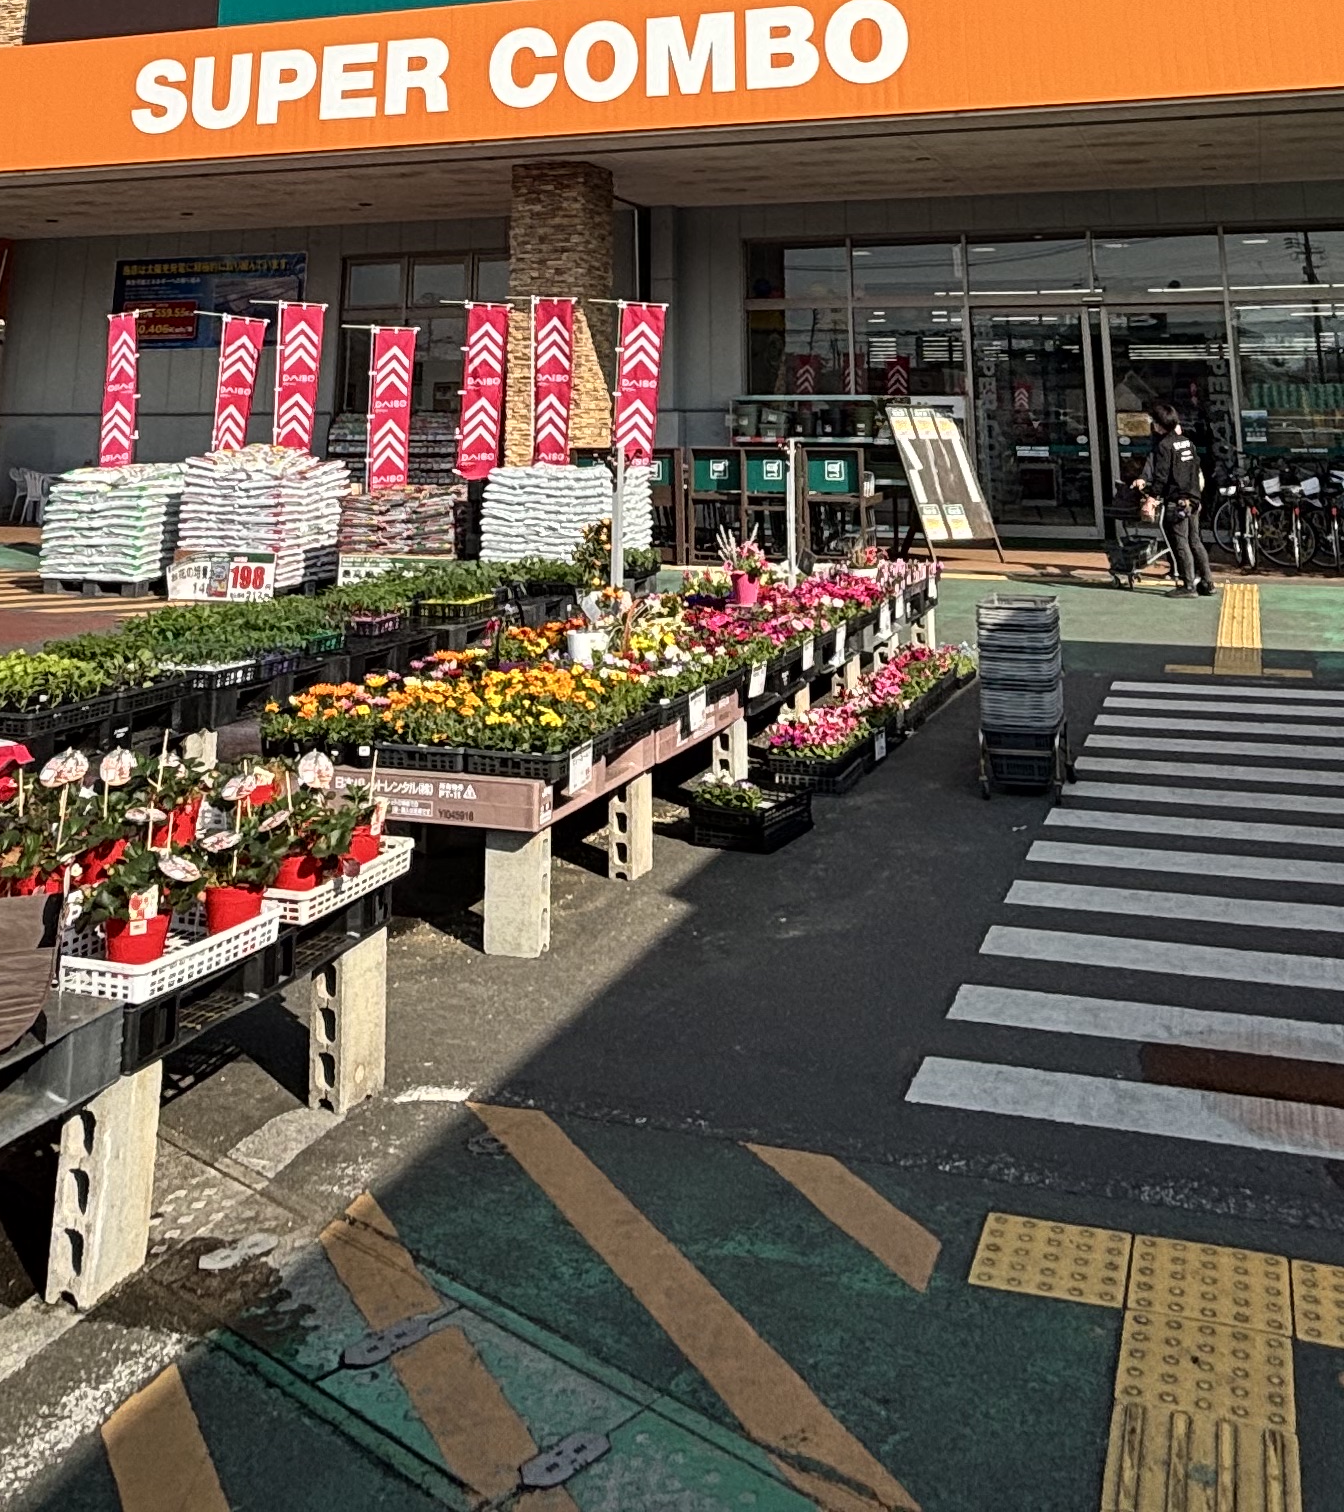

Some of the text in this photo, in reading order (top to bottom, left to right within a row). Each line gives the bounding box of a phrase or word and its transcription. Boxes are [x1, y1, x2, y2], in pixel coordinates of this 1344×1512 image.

[130, 36, 450, 136] SUPER
[467, 376, 501, 386] DAISO
[621, 379, 657, 388] DAISO
[375, 399, 407, 409] DAISO
[373, 474, 404, 484] DAISO
